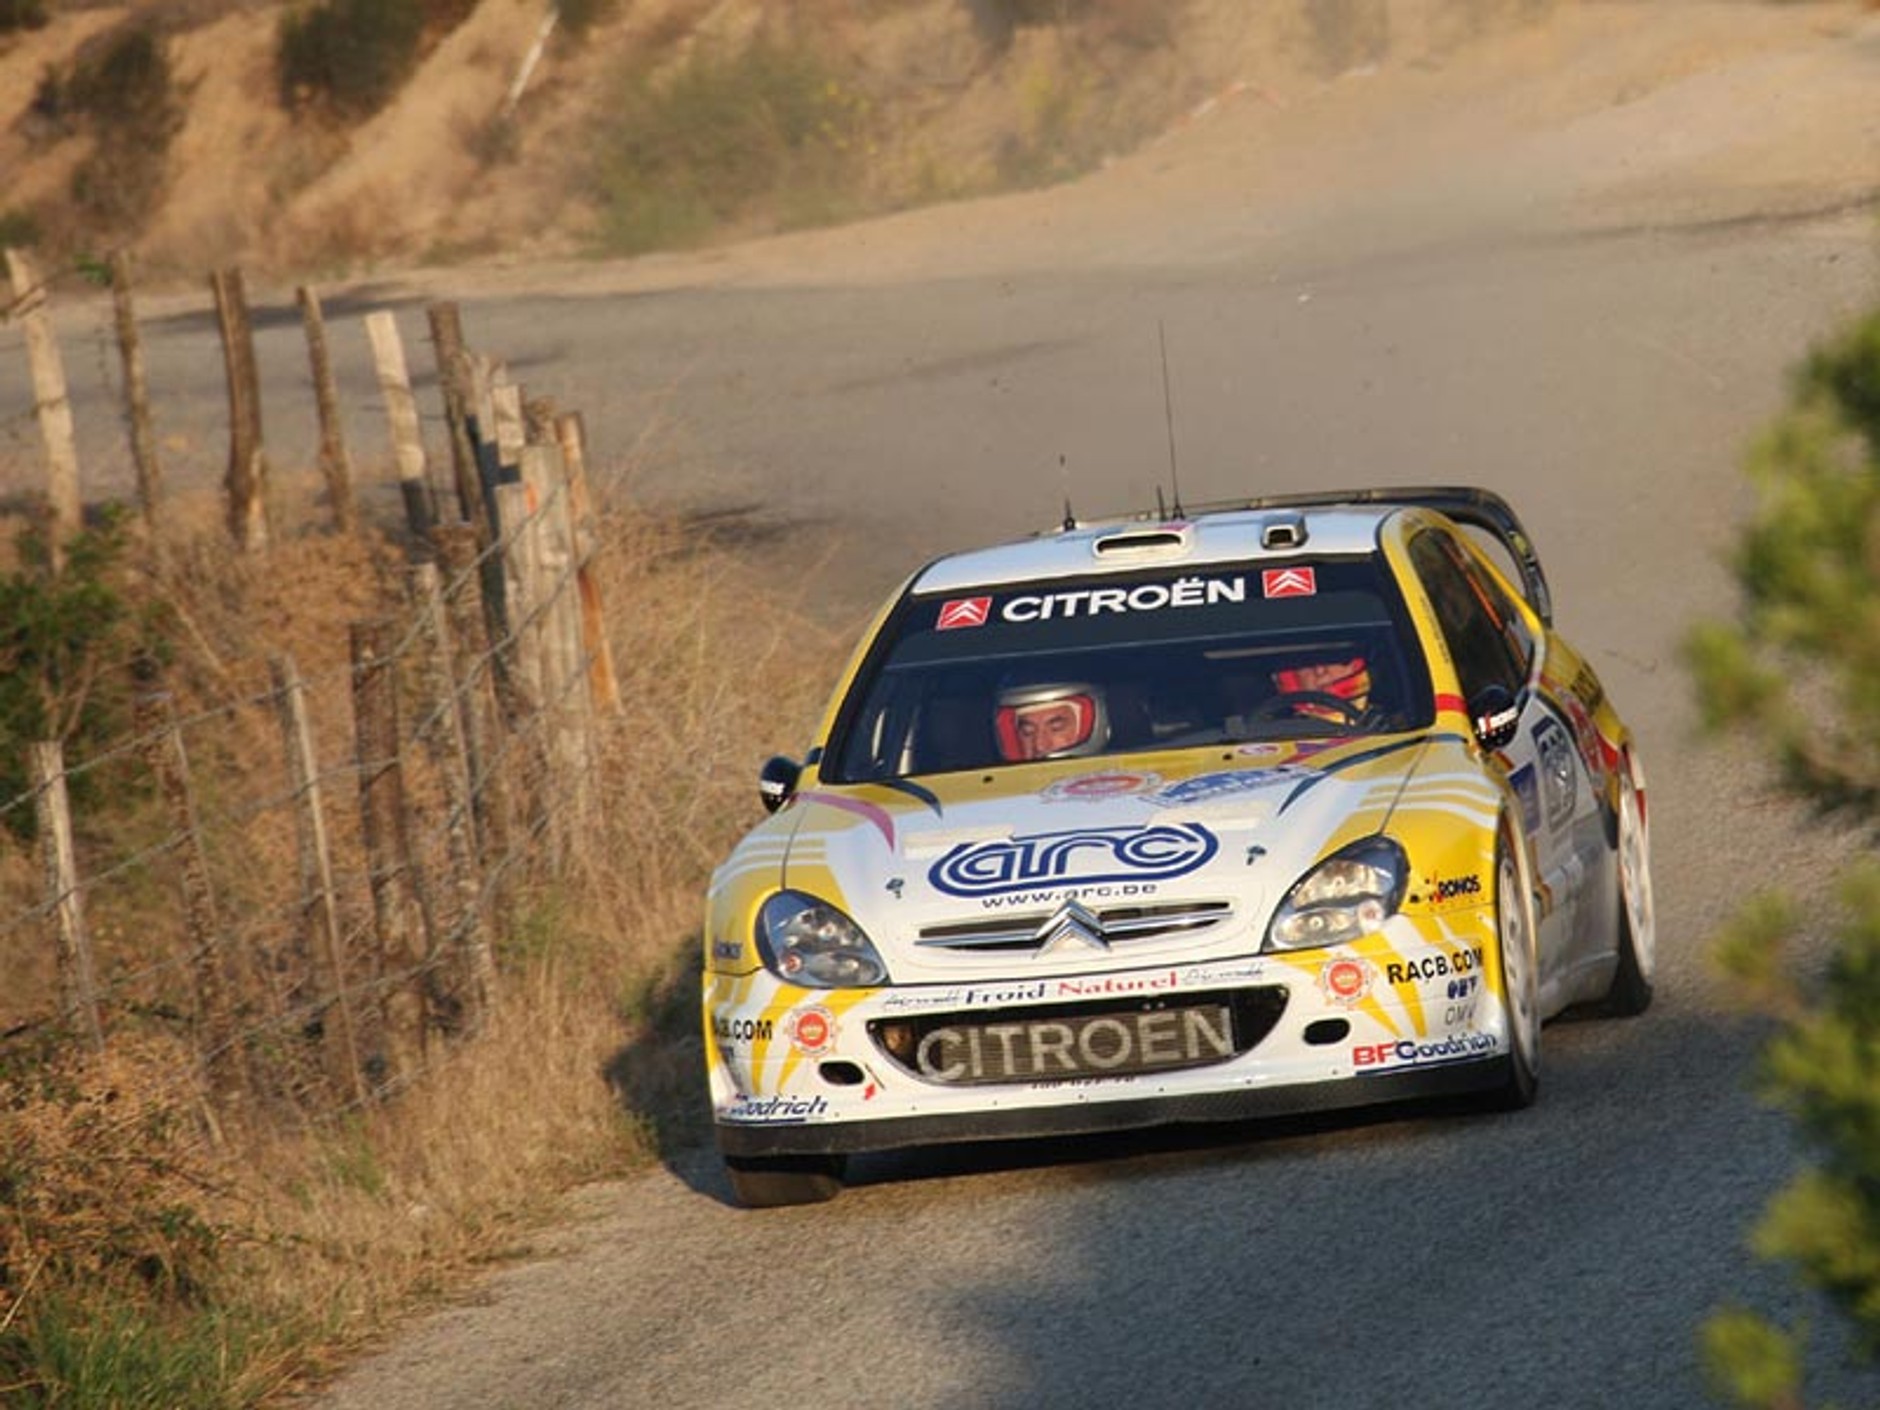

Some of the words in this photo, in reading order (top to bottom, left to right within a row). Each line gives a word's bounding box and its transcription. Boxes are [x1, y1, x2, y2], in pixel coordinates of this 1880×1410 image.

[1002, 577, 1245, 622] CITROËN
[936, 823, 1212, 892] arc
[982, 883, 1158, 908] www.arc.be
[1387, 947, 1484, 985] RACB.COM
[965, 983, 1046, 1005] Froid
[1058, 971, 1178, 997] Naturel
[917, 1002, 1235, 1083] CITROËN
[1353, 1032, 1498, 1066] BFGoodrich
